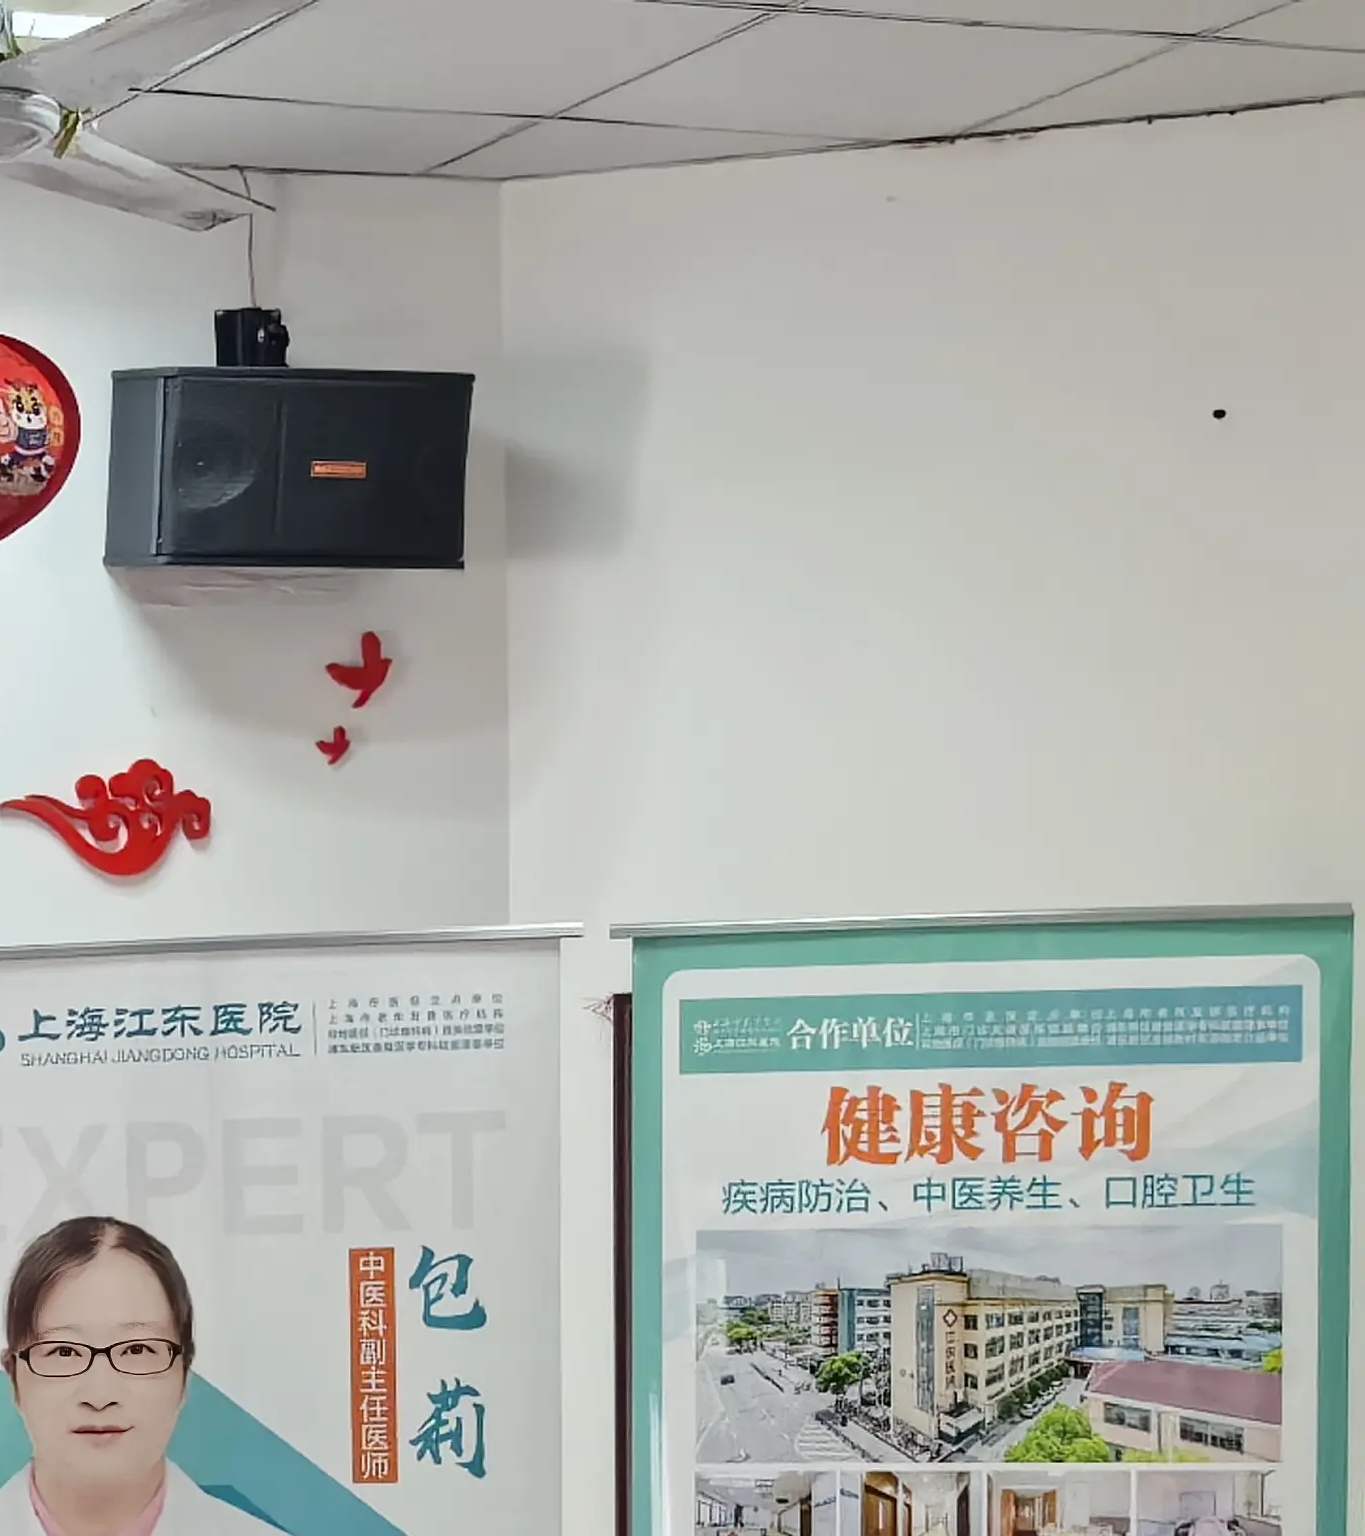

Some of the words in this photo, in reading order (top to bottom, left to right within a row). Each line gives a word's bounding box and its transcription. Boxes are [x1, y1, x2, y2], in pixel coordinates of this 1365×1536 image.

[17, 1000, 304, 1043] 上海江东医院
[786, 1015, 914, 1050] 合作单位
[20, 1050, 109, 1068] SHANGHAI
[111, 1046, 210, 1065] JIANGDONG
[213, 1042, 301, 1062] HOSPITAL
[820, 1080, 1154, 1167] 健康咨询
[721, 1172, 1257, 1215] 疾病防治、中医养生、口腔卫生
[357, 1251, 390, 1479] 中医科副主任医师
[408, 1245, 488, 1479] 包莉
